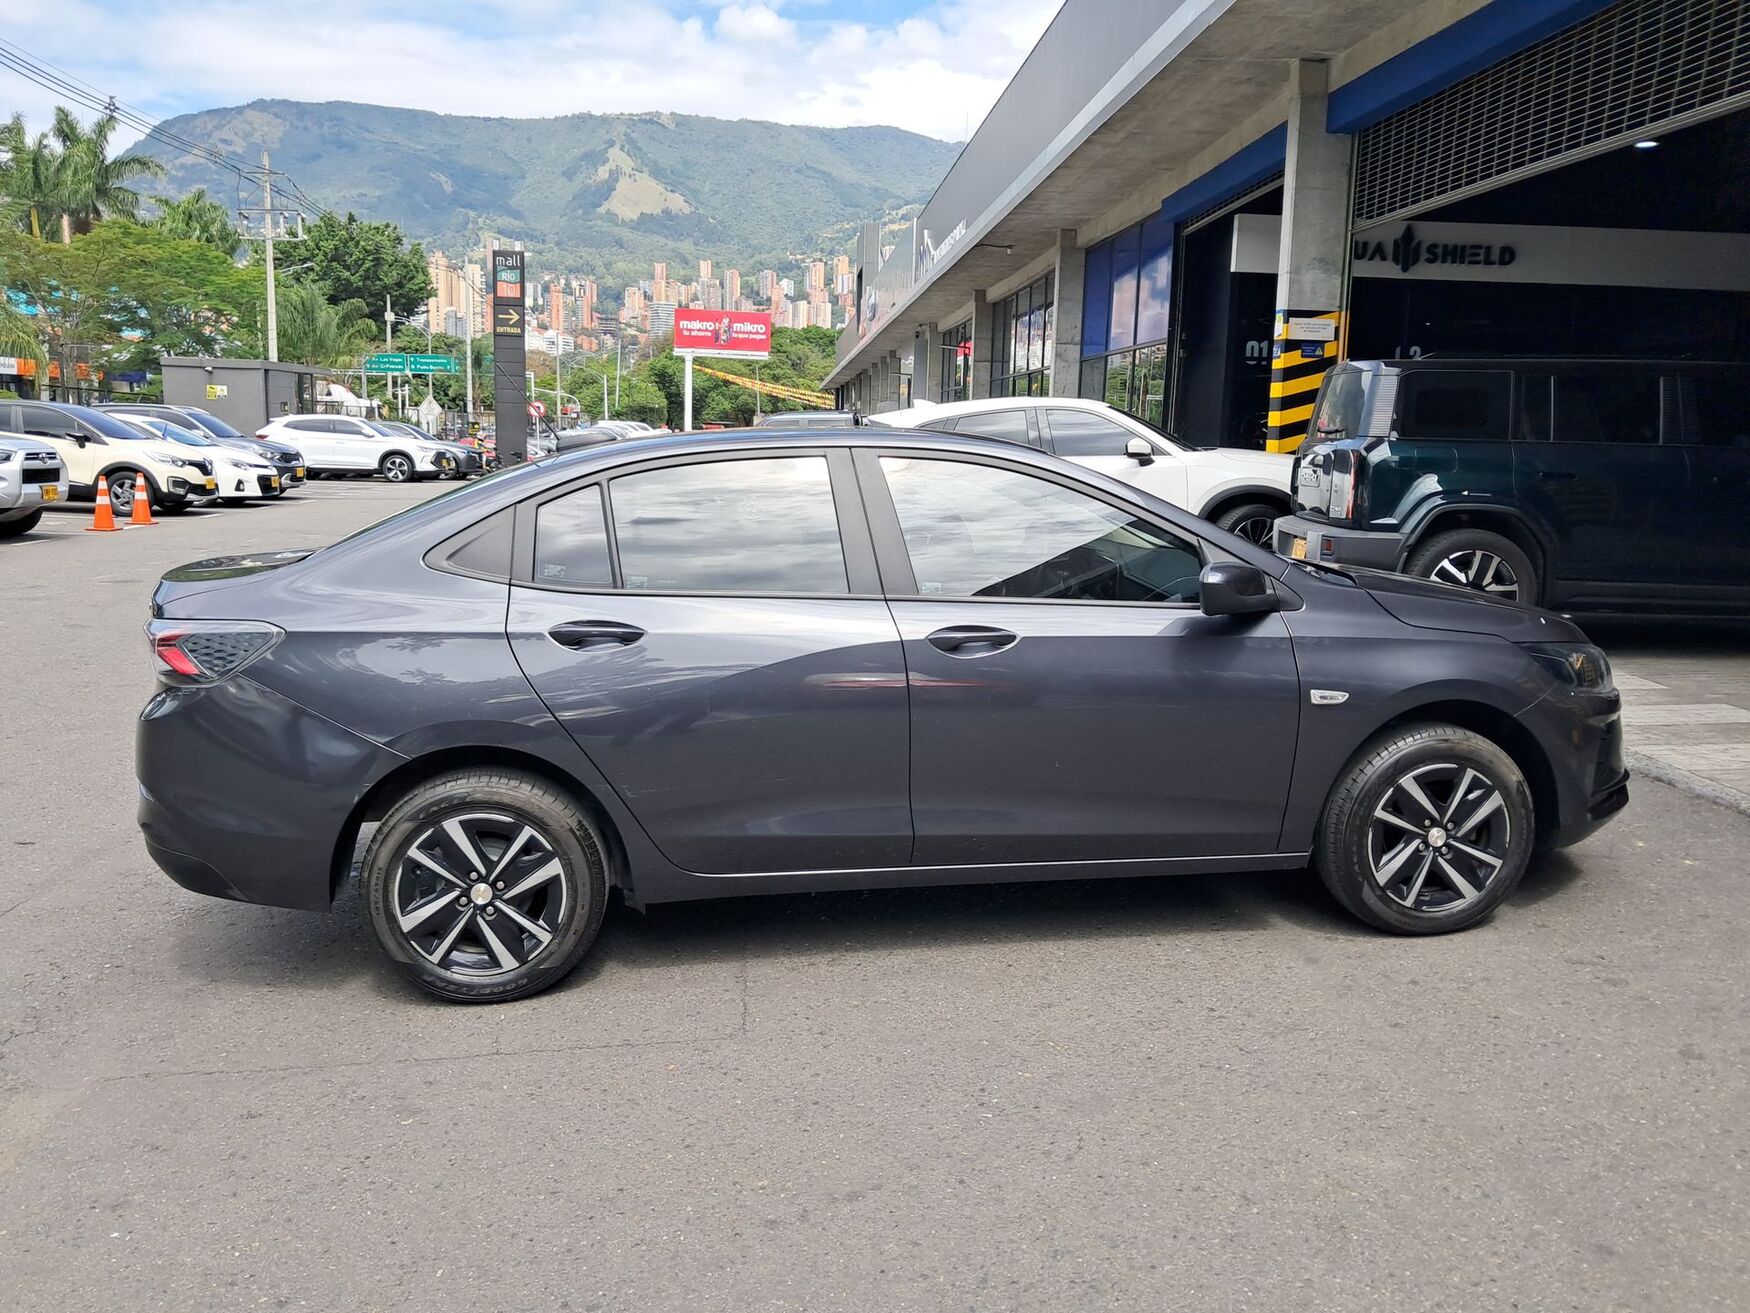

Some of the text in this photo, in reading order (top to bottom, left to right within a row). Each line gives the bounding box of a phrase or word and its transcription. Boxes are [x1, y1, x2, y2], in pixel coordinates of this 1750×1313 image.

[496, 254, 521, 267] mall
[1424, 243, 1517, 266] SHIELD
[502, 284, 516, 297] 10
[680, 320, 715, 330] makro
[733, 322, 766, 333] mikro
